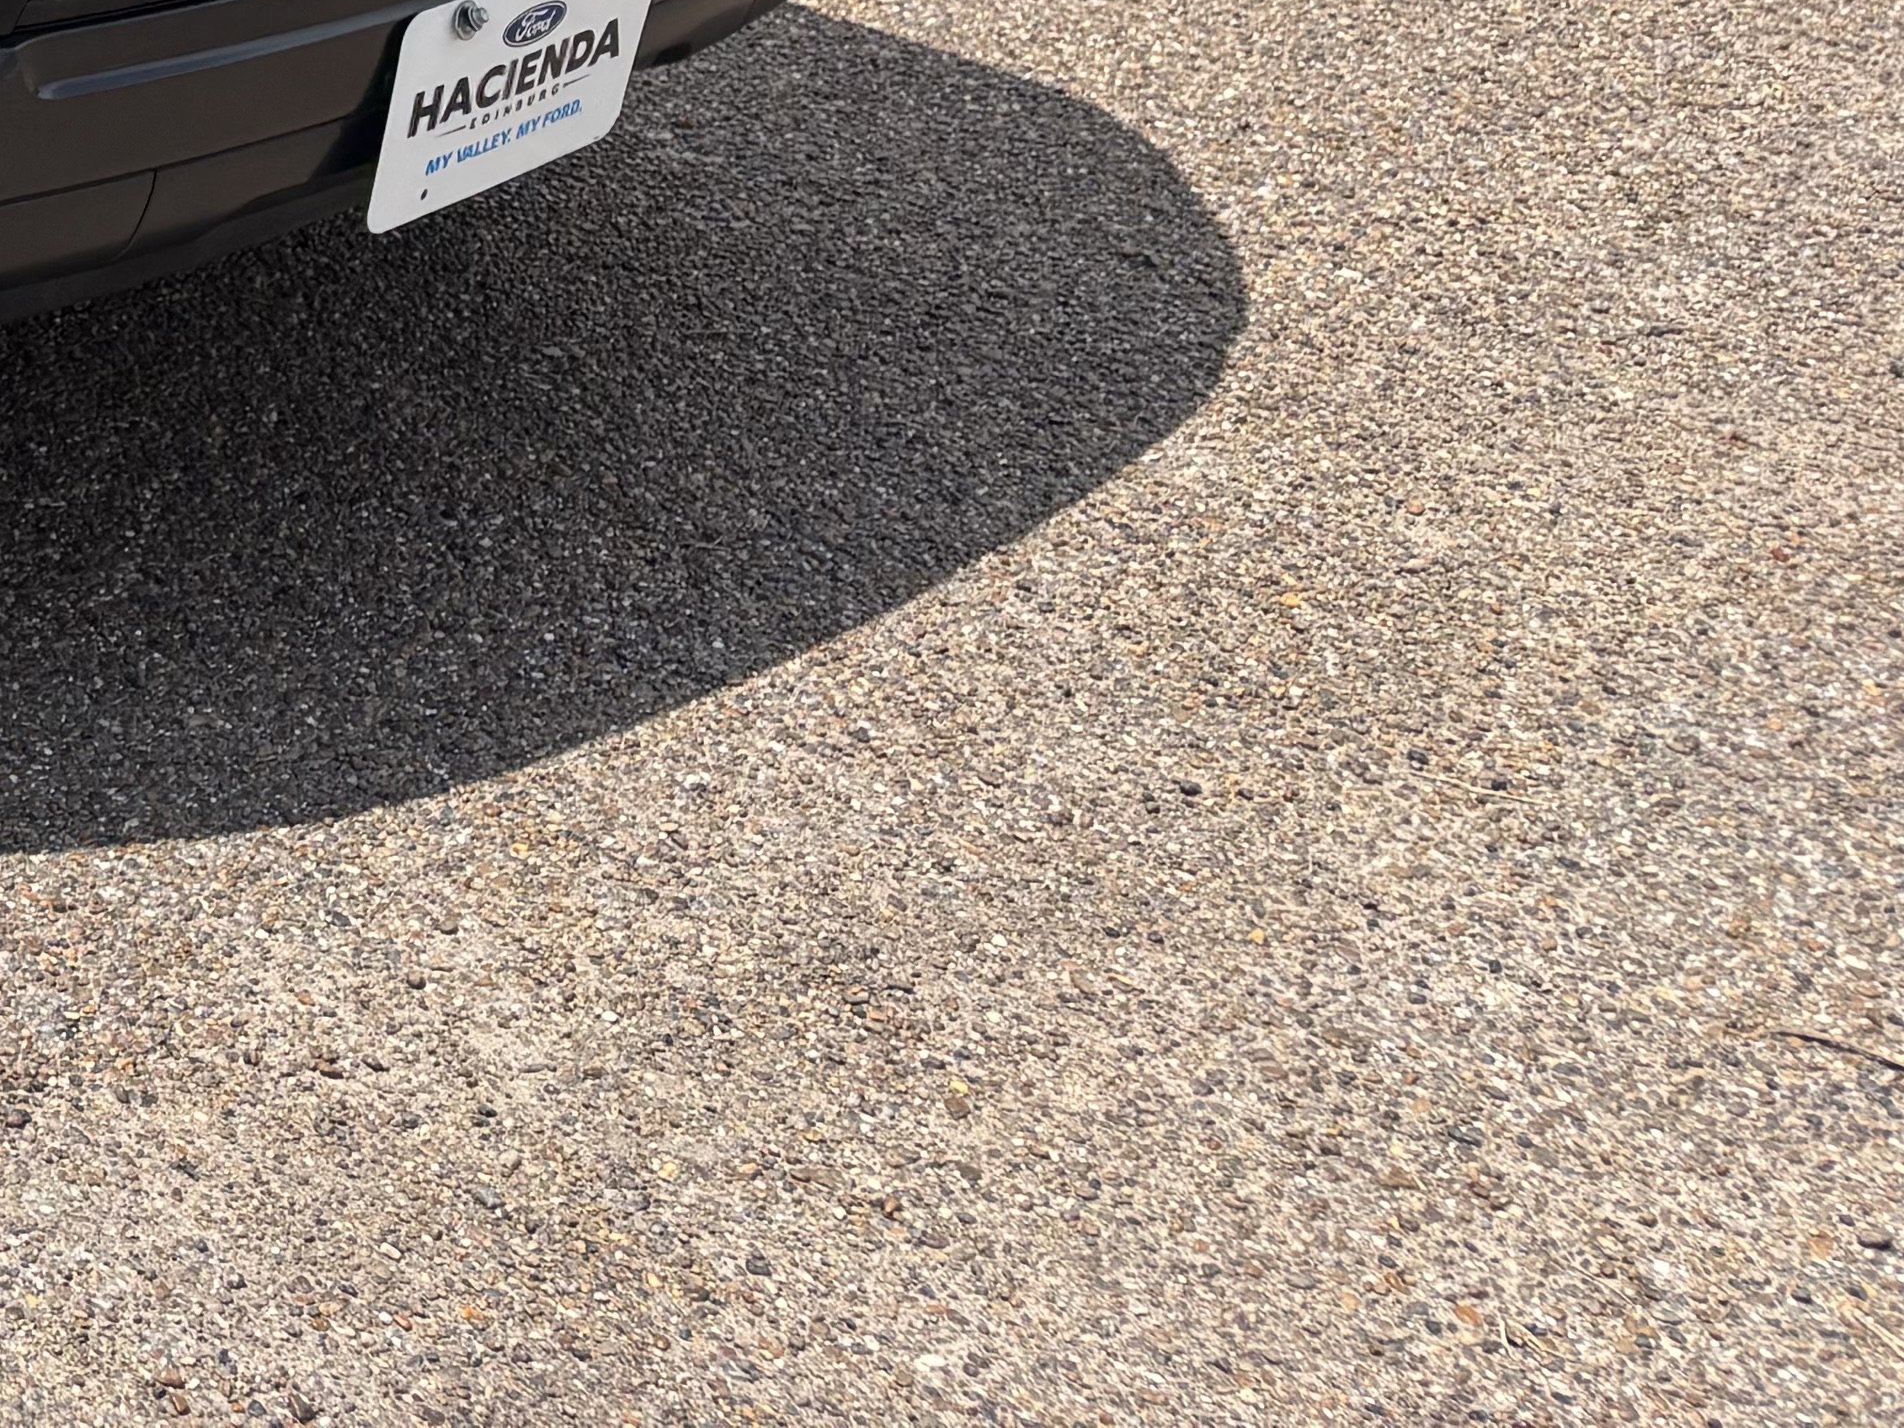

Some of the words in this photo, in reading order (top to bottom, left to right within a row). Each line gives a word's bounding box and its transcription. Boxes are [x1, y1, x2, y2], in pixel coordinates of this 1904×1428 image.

[515, 7, 556, 42] Ford
[406, 16, 620, 139] HACIENDA
[469, 82, 561, 131] EDINBURG
[424, 150, 454, 177] MY
[515, 115, 542, 140] MY
